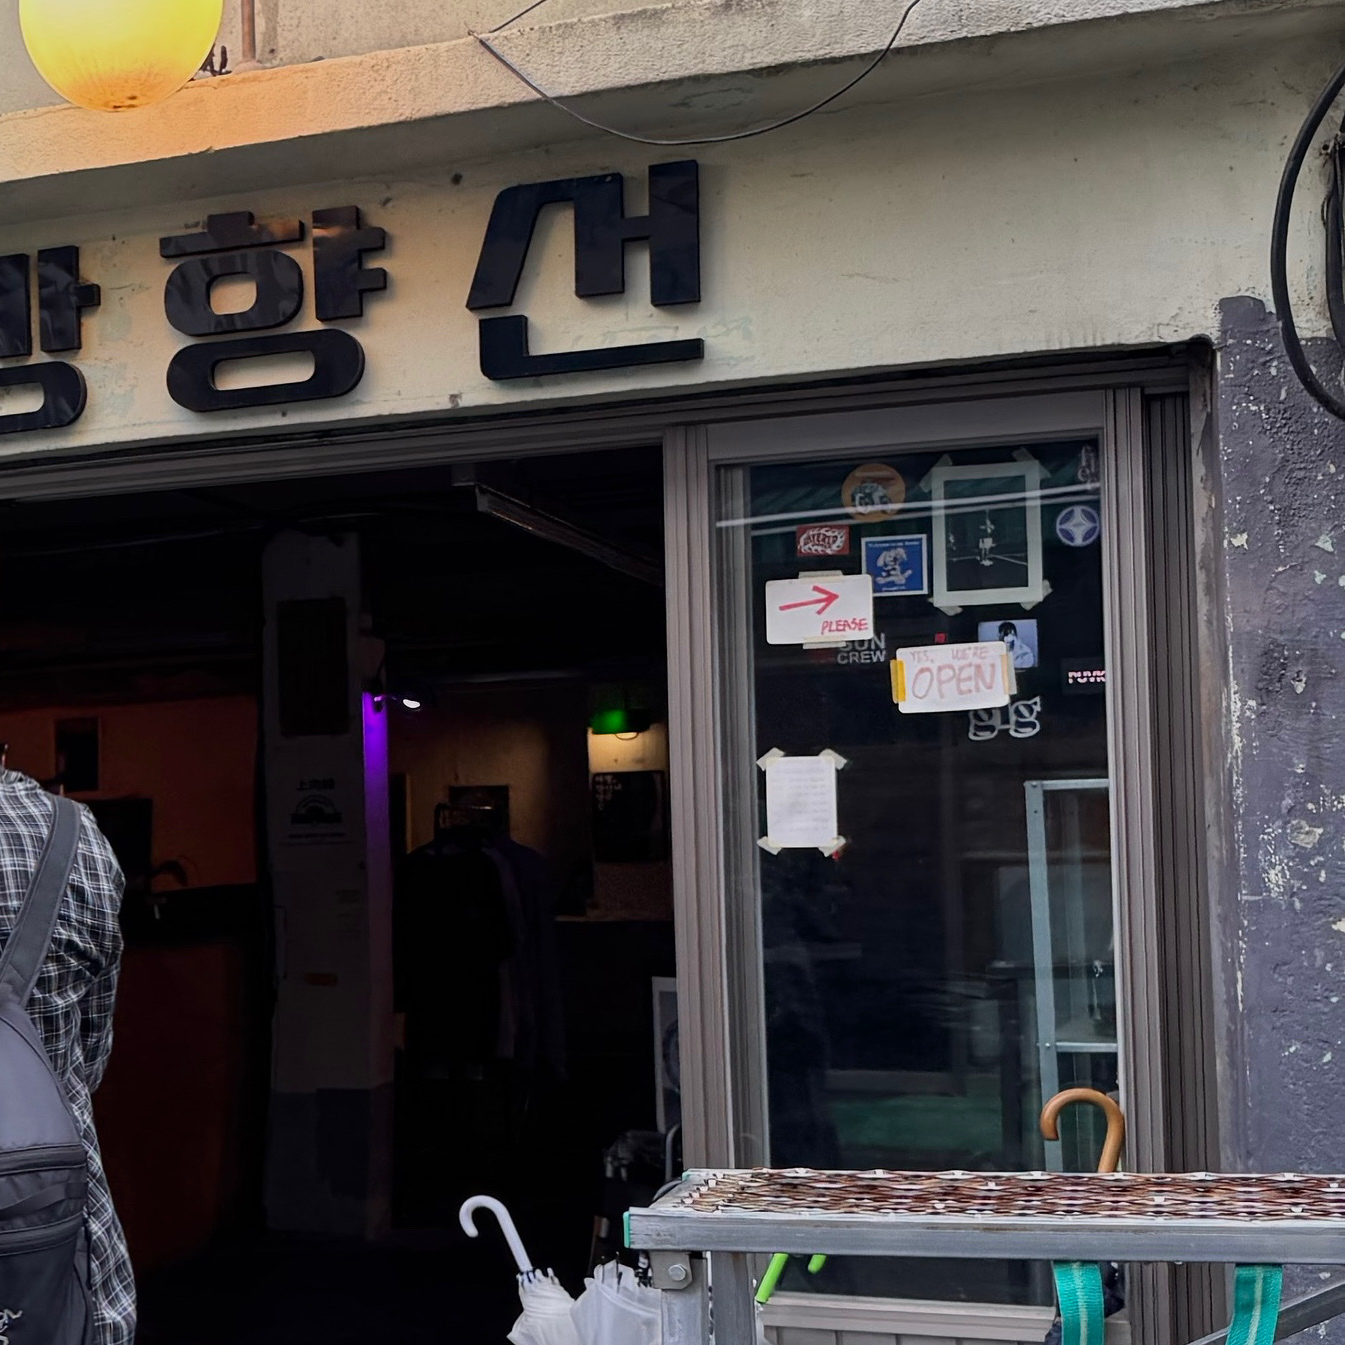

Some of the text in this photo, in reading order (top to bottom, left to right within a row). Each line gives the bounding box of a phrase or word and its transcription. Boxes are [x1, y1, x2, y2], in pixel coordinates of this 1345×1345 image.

[821, 618, 868, 635] PLEASE
[837, 649, 886, 665] CREW
[912, 662, 996, 700] OPEN
